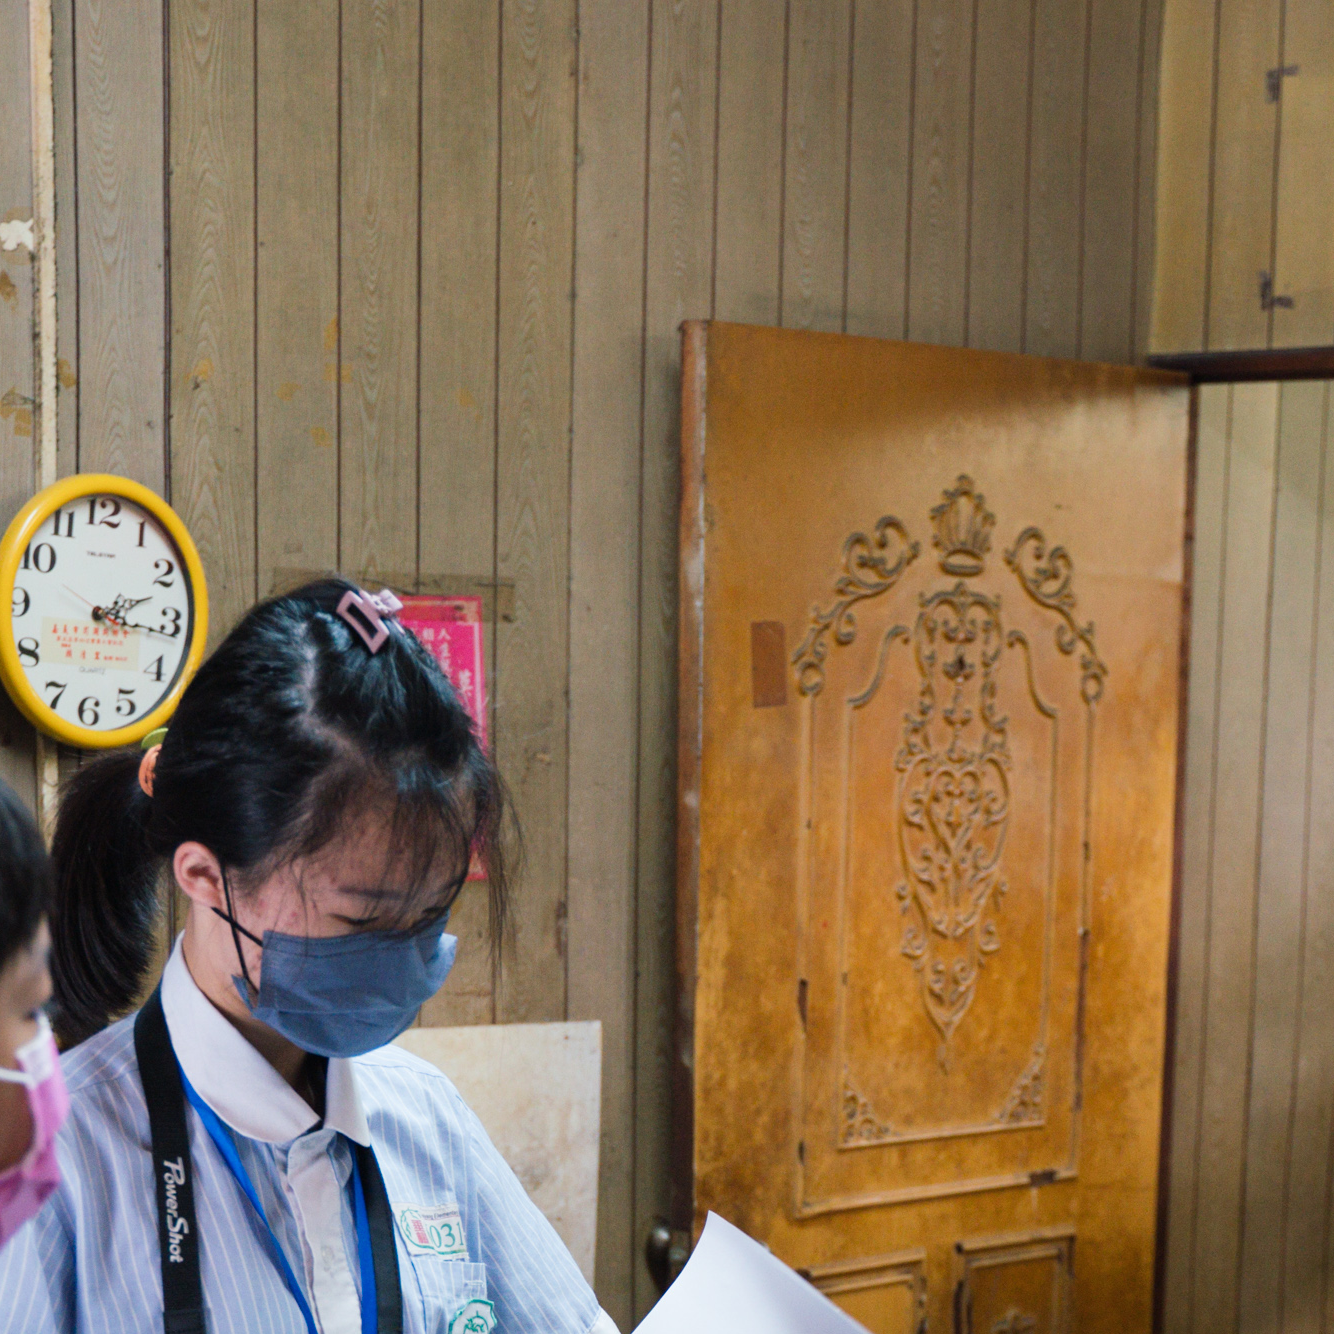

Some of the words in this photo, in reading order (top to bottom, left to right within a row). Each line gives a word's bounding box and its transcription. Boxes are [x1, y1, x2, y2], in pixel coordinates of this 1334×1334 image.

[51, 509, 75, 539] 11
[86, 499, 121, 529] 12
[136, 521, 146, 548] 1
[21, 541, 57, 573] 10
[152, 558, 175, 588] 2
[11, 587, 31, 617] 9
[160, 606, 182, 639] 3
[17, 637, 41, 668] 8
[143, 654, 167, 682] 4
[45, 680, 68, 710] 7
[115, 688, 136, 717] 5
[77, 696, 101, 726] 6
[163, 1156, 189, 1263] PowerShot
